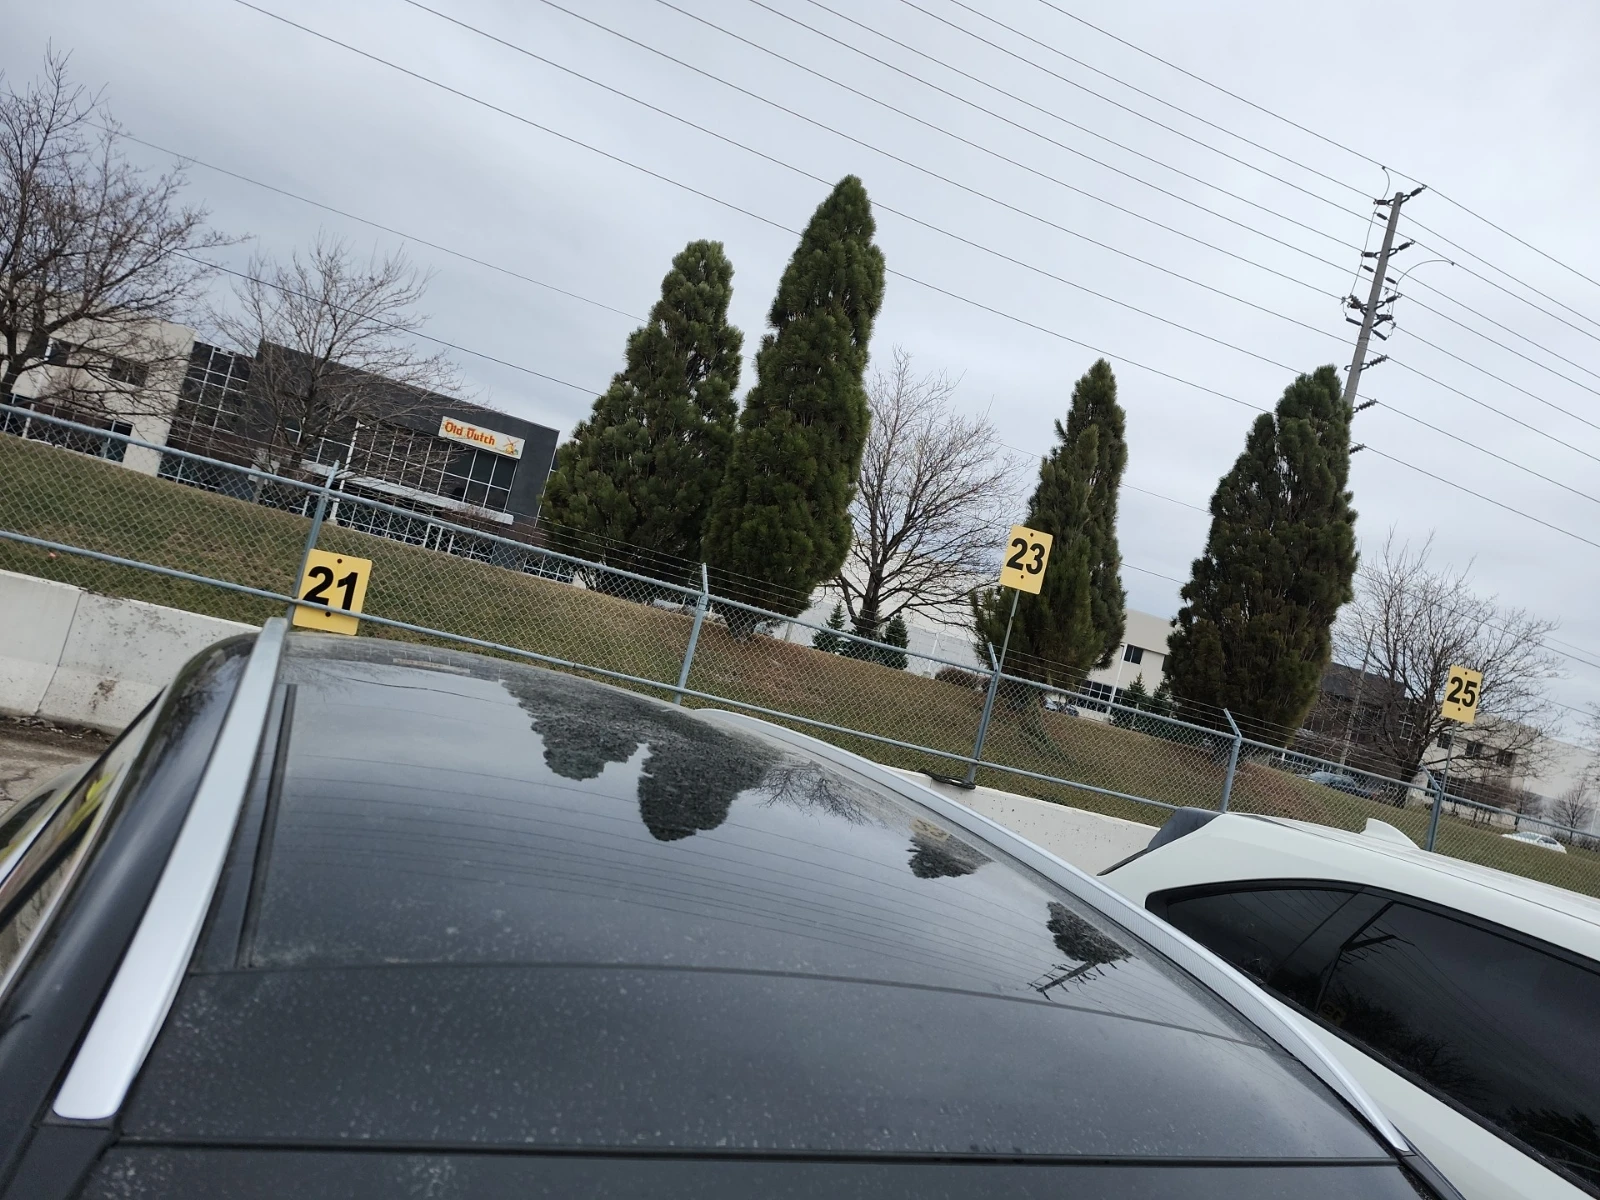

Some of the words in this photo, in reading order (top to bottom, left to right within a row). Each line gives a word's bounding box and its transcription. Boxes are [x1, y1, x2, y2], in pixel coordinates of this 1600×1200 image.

[444, 421, 463, 436] Old
[466, 427, 496, 446] Dutch
[1006, 537, 1046, 575] 23
[302, 565, 359, 611] 21
[1446, 676, 1478, 707] 25
